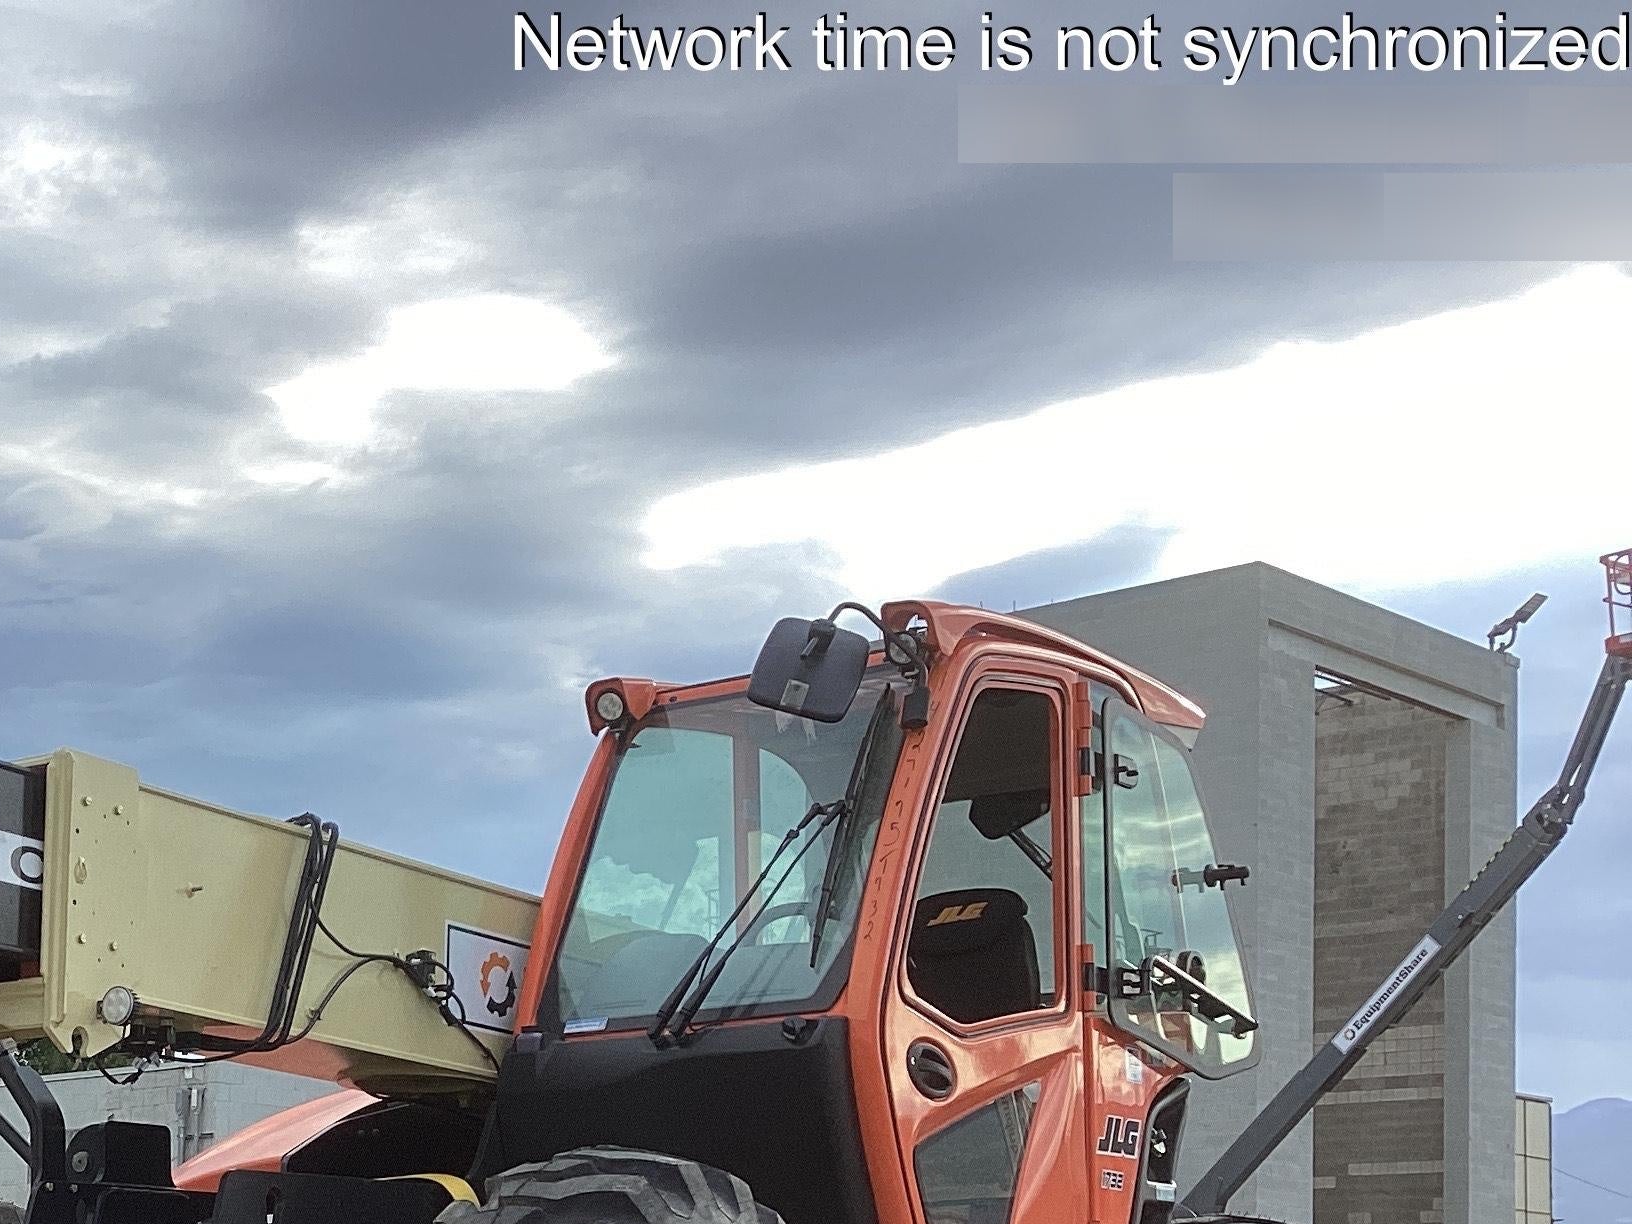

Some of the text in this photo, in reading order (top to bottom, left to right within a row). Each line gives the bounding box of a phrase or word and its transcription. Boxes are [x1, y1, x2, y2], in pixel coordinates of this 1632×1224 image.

[927, 901, 988, 927] JLG
[1352, 948, 1428, 1031] EquipmentShare
[1096, 1115, 1141, 1159] JLG
